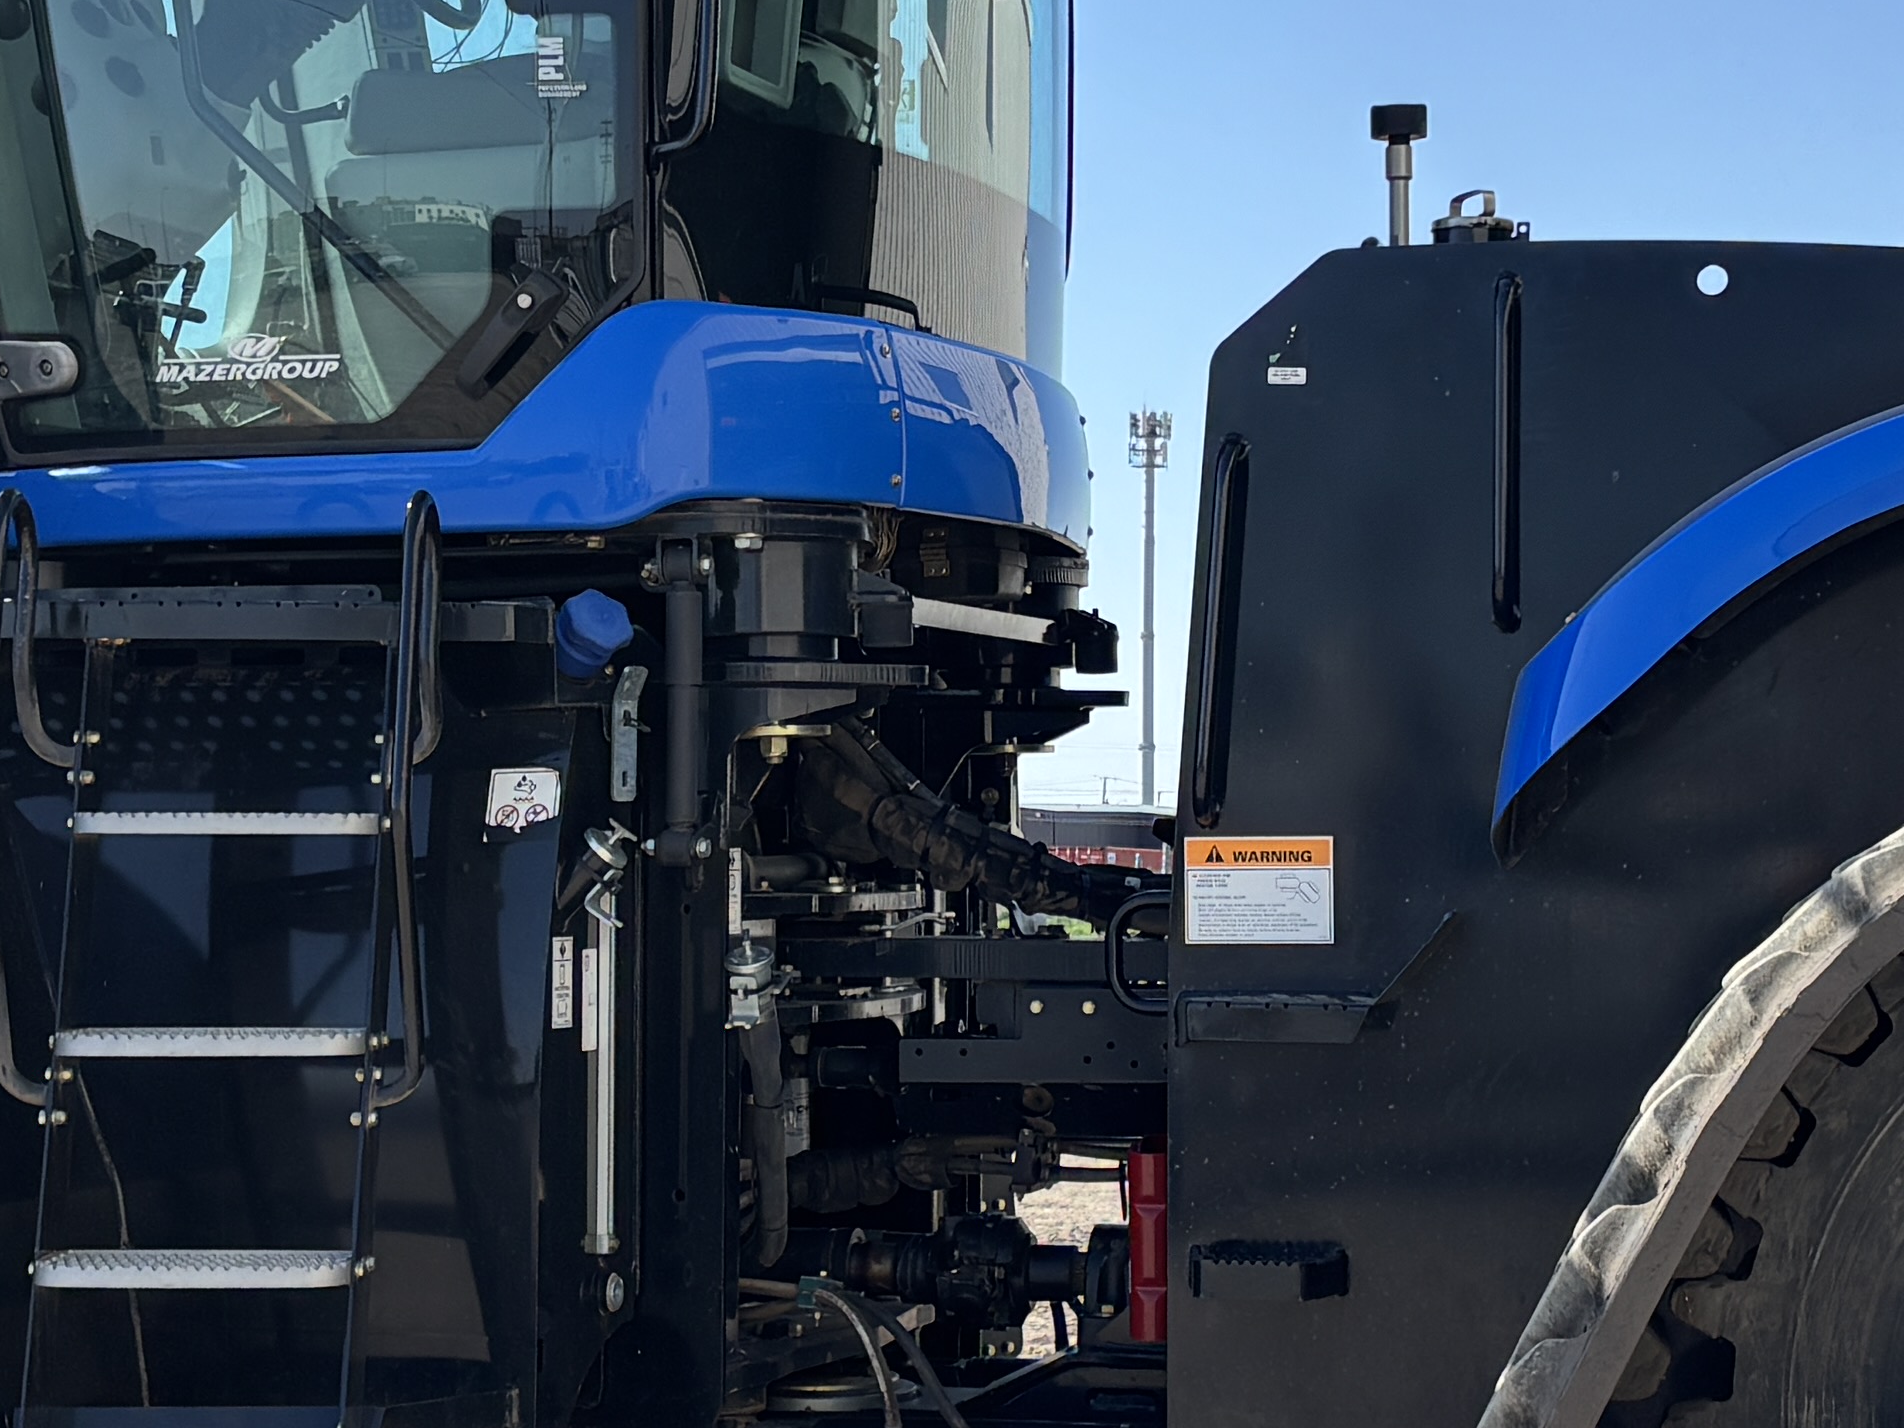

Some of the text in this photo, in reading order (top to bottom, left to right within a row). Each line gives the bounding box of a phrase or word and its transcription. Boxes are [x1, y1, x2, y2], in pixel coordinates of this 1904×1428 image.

[537, 37, 564, 81] PLM
[155, 360, 340, 384] MAZERGROUP
[1232, 850, 1313, 863] WARNING
